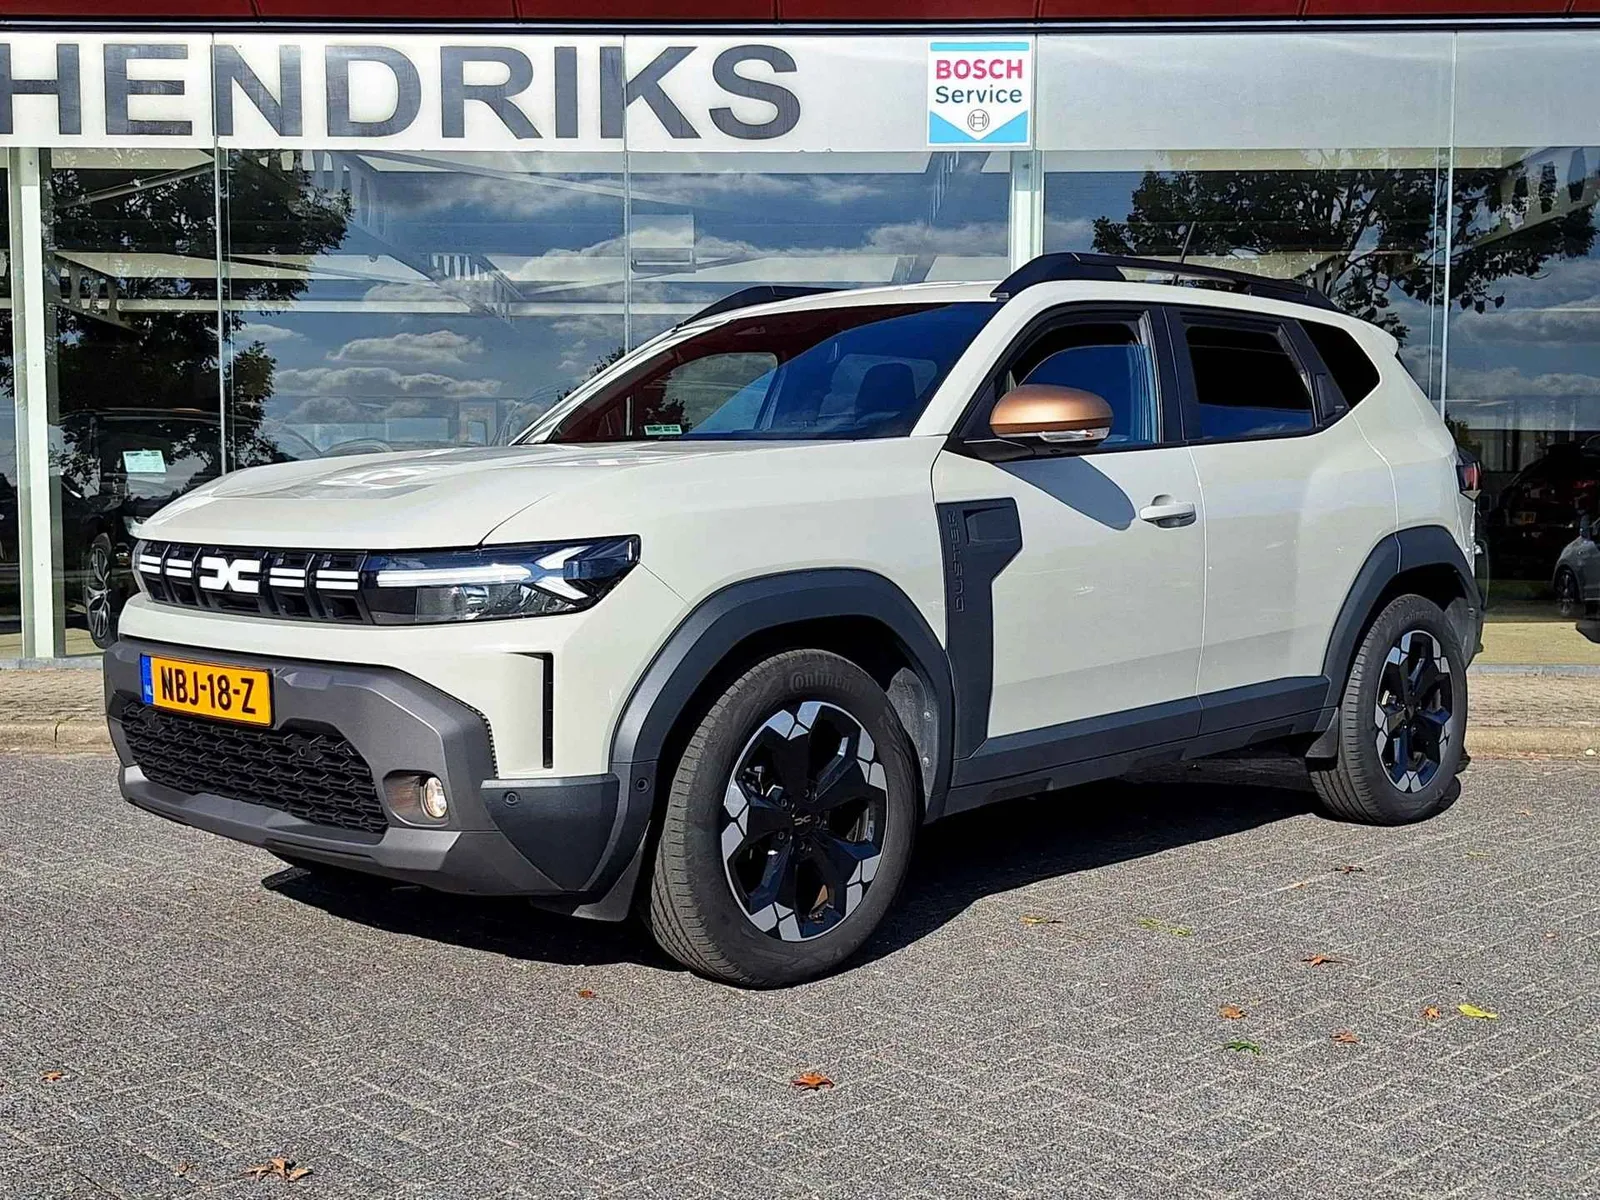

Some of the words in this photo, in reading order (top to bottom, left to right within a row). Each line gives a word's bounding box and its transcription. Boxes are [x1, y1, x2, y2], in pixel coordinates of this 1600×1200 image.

[0, 43, 801, 140] HENDRIKS
[935, 58, 1023, 80] BOSCH
[935, 84, 1023, 104] Service
[948, 509, 965, 613] DUSTER
[160, 665, 257, 715] NBJ-18-Z
